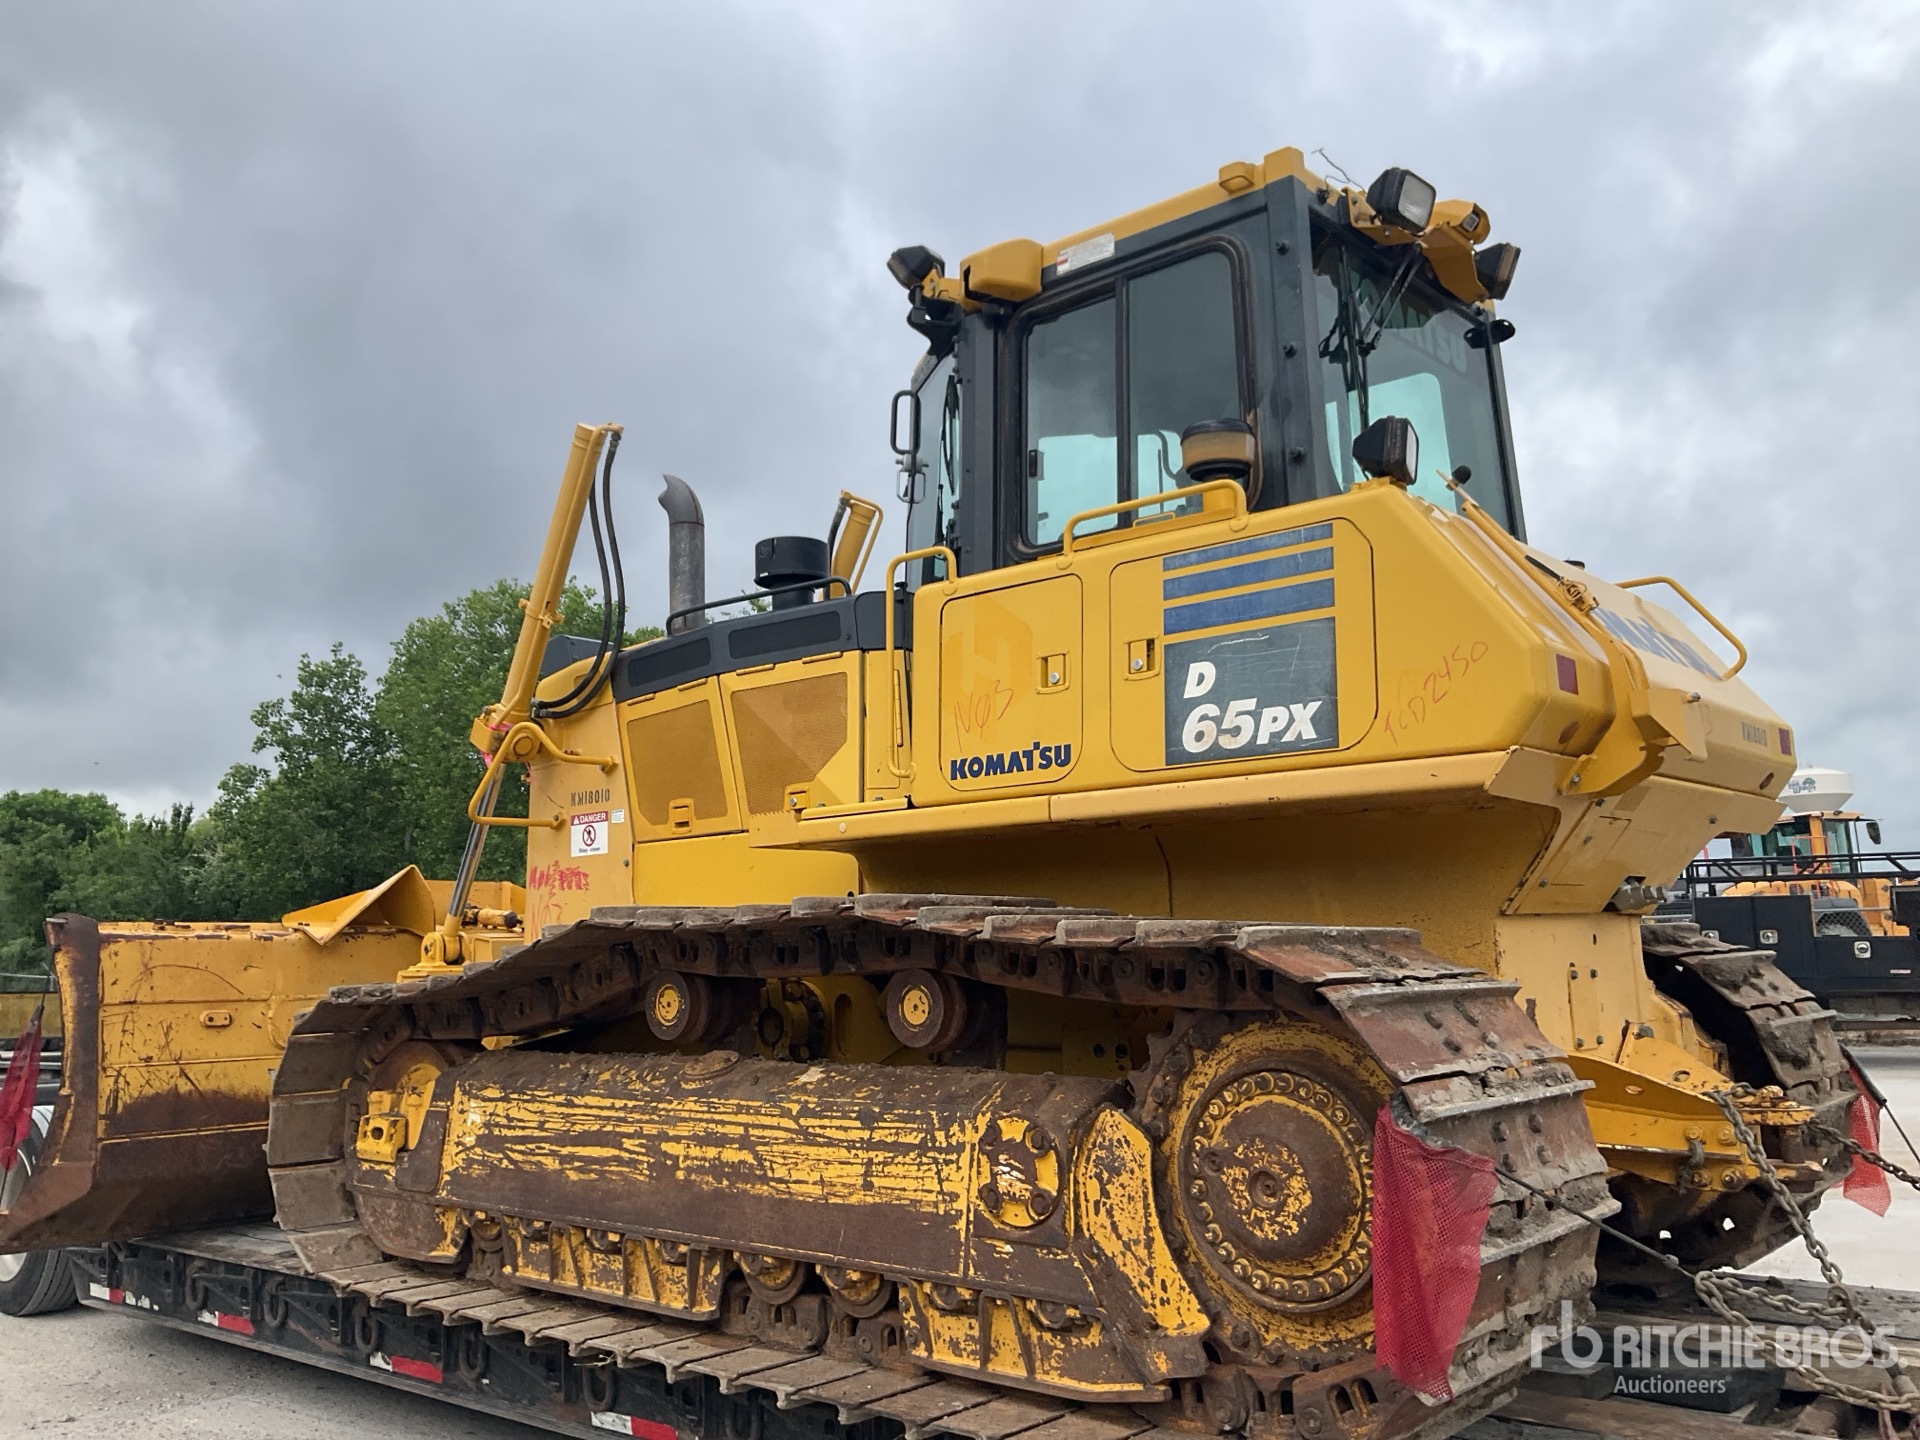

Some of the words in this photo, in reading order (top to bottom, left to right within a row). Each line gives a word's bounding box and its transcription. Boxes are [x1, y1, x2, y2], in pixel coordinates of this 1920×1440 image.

[1183, 661, 1216, 699] D
[1181, 698, 1323, 753] 65PX
[950, 741, 1072, 781] KOMATSU
[580, 812, 606, 824] DANGER
